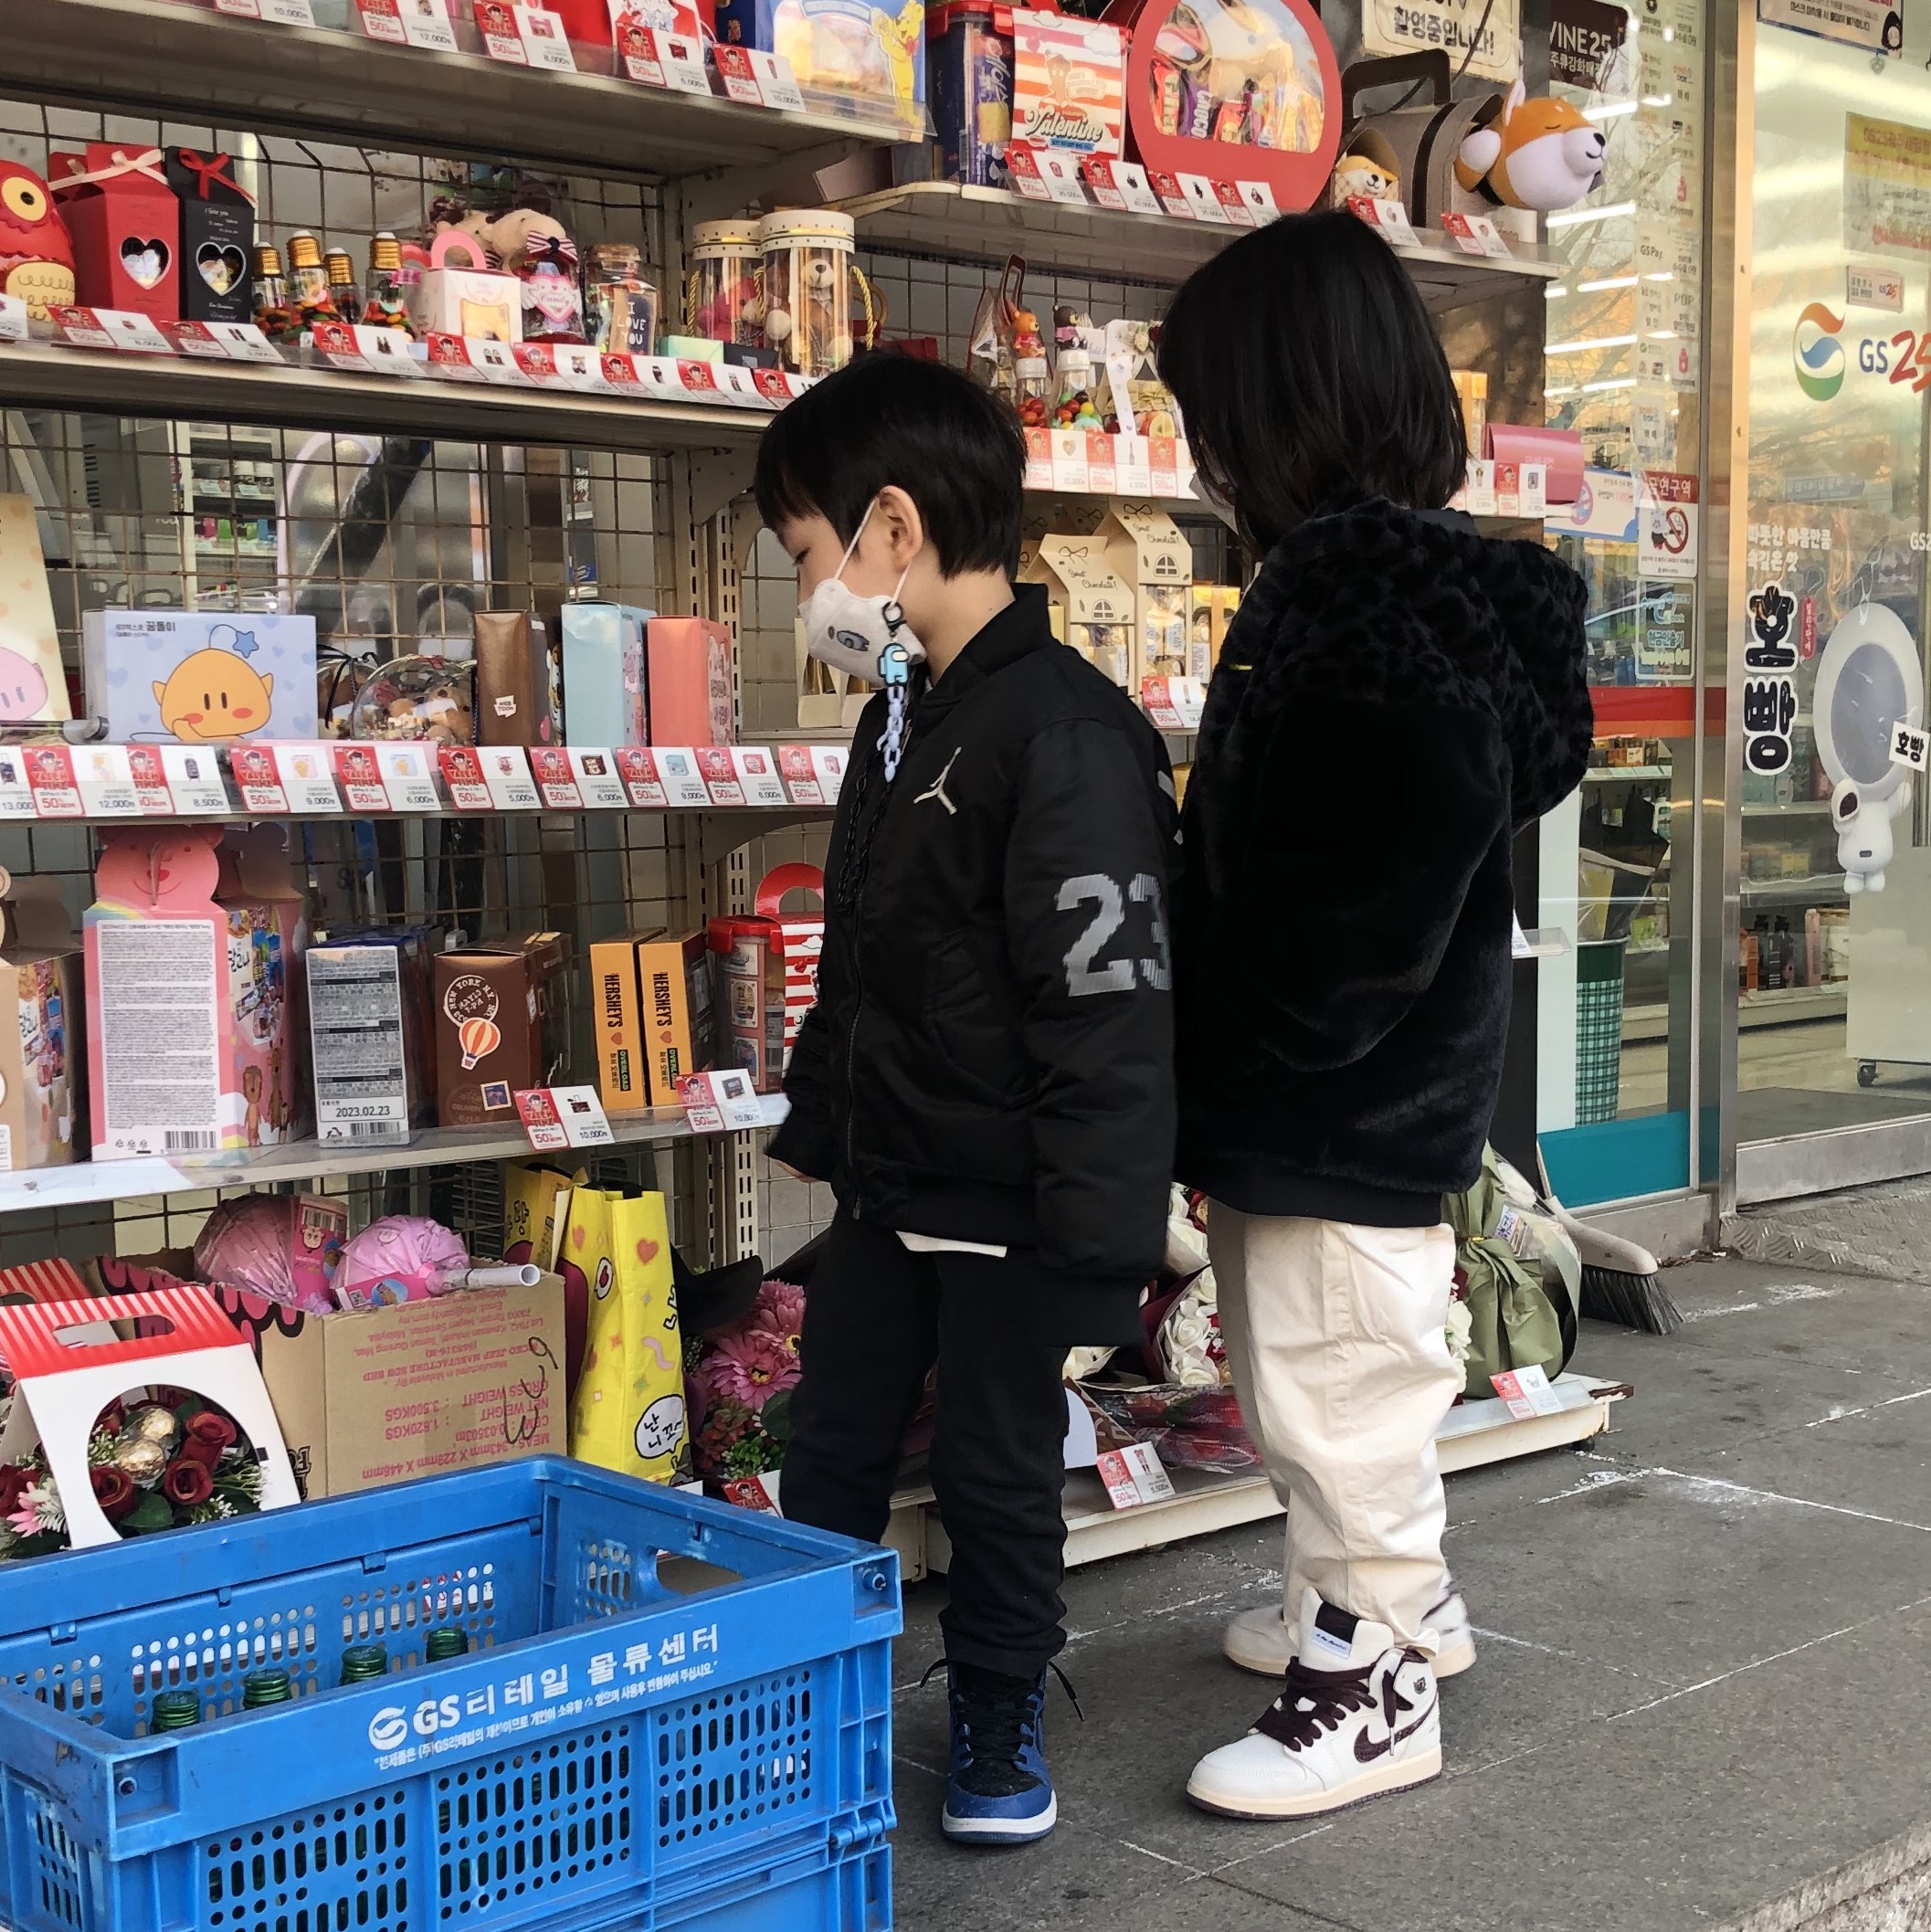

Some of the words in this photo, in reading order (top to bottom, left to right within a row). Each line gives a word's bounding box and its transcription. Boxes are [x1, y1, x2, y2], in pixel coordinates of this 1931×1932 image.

[1024, 109, 1103, 143] Valentine
[628, 301, 636, 314] I
[617, 316, 647, 331] LOVE
[621, 333, 643, 345] YOU
[1859, 330, 1931, 393] GS25
[1895, 732, 1924, 763] 호빵
[1054, 873, 1172, 998] 23
[456, 978, 481, 989] YORK
[605, 972, 623, 1028] HERSHEY'S
[653, 971, 672, 1027] HERSHEY'S
[619, 1050, 629, 1091] OVERLOAD
[336, 1105, 390, 1118] 2023.02.23
[461, 1386, 506, 1408] WEIGHT
[528, 1398, 548, 1411] NET
[385, 1399, 438, 1421] 3.500KGS
[480, 1402, 524, 1421] WEIGHT
[644, 1412, 659, 1432] 난
[406, 1460, 415, 1473] X
[459, 1450, 468, 1462] X
[413, 1663, 568, 1735] GS리테일
[586, 1623, 718, 1686] 물류센터
[557, 1699, 583, 1717] 소유할
[621, 1681, 646, 1699] 사용후
